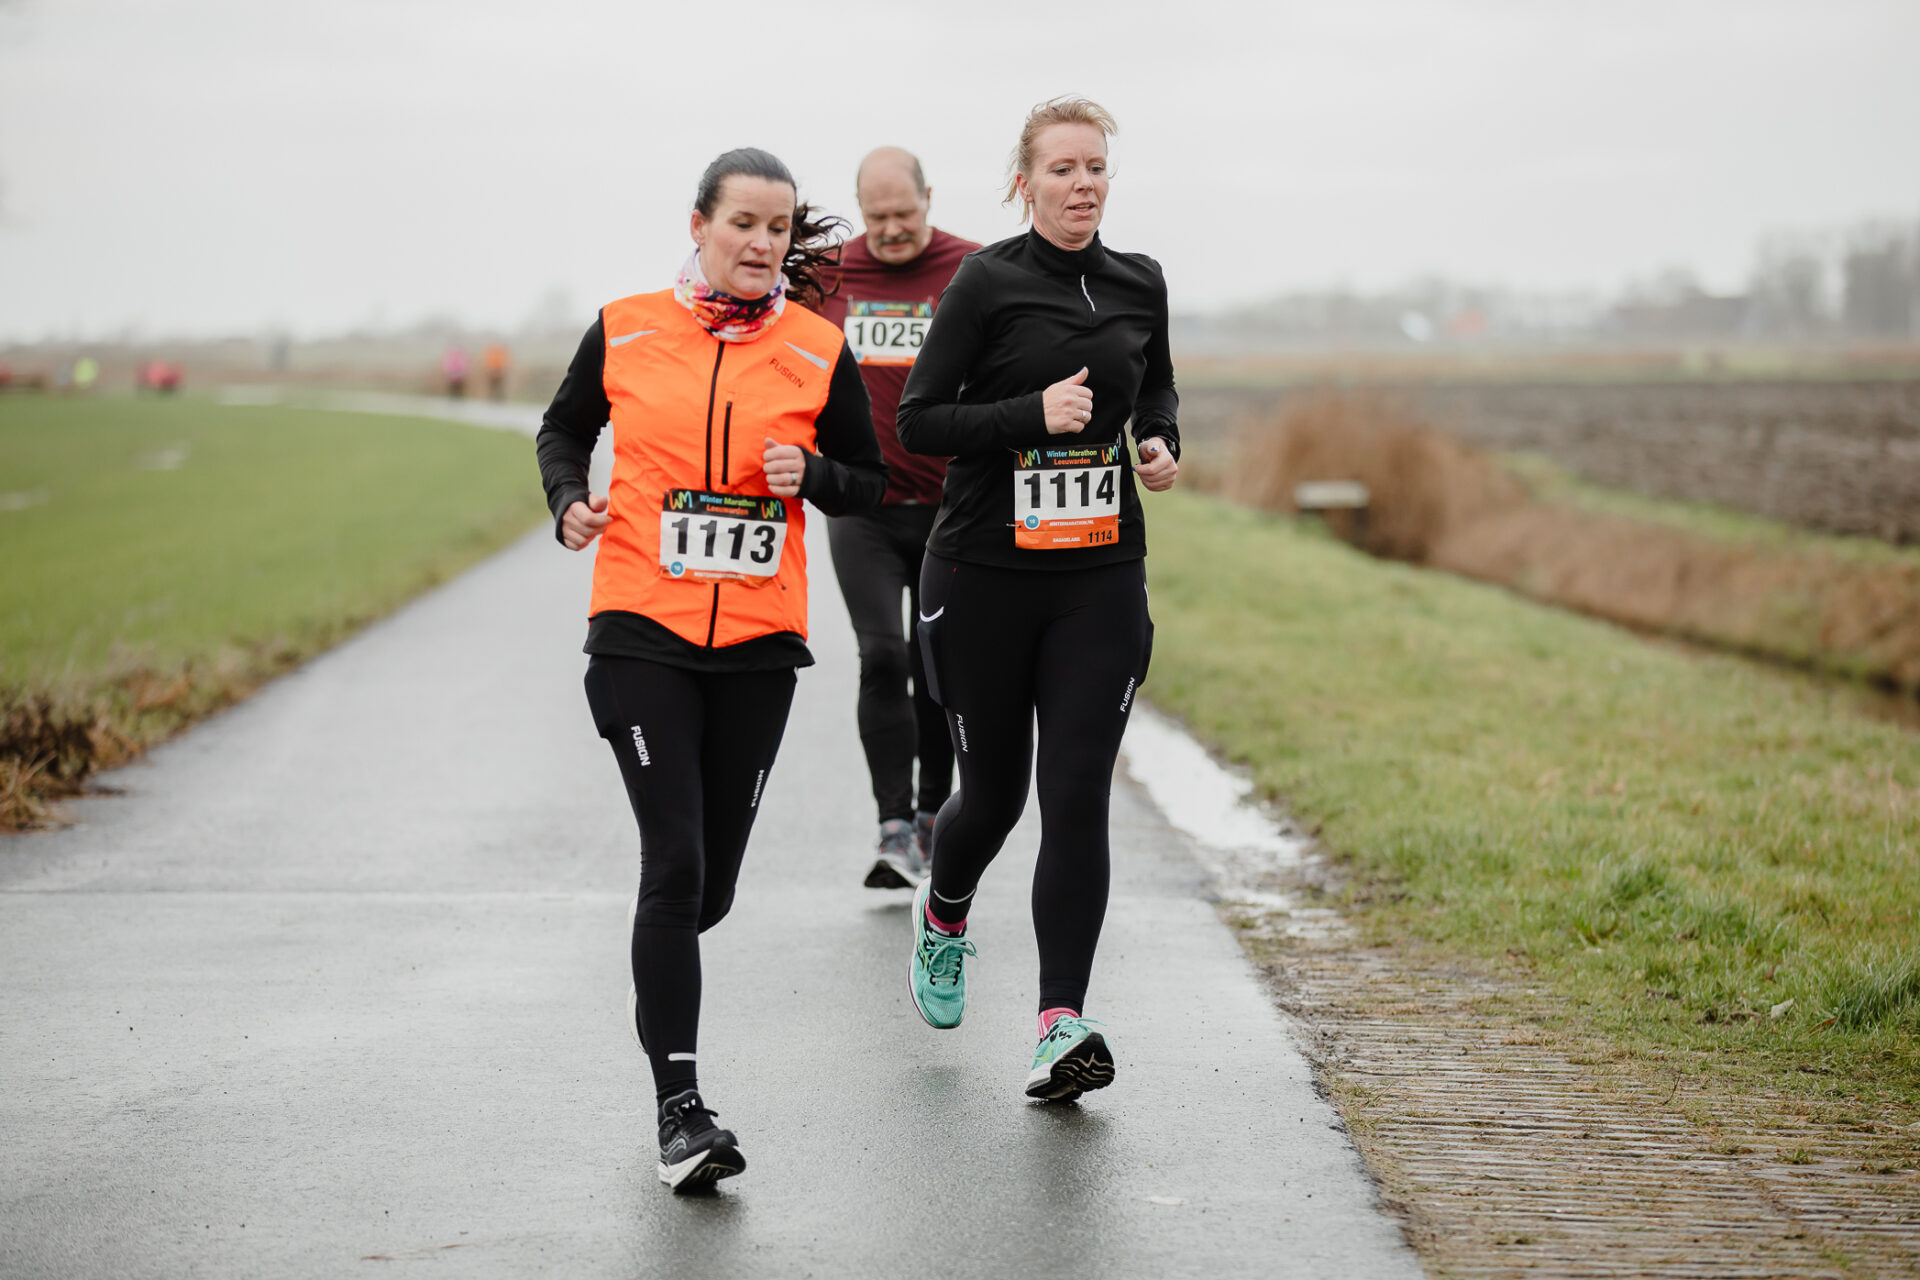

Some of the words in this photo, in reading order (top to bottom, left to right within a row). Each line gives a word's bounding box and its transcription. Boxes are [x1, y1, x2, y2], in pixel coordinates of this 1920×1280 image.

[854, 321, 924, 348] 1025
[769, 358, 805, 388] FUSION
[1046, 450, 1068, 458] Winter
[1069, 449, 1098, 457] Marathon
[1053, 457, 1091, 465] Leeuwarden
[699, 494, 723, 505] Winter
[723, 497, 757, 508] Marathon
[1023, 470, 1115, 508] 1114
[671, 517, 776, 564] 1113
[1087, 530, 1113, 544] 1114
[1119, 676, 1135, 713] FUSION
[631, 725, 651, 767] FUSION
[956, 713, 968, 753] FUSION
